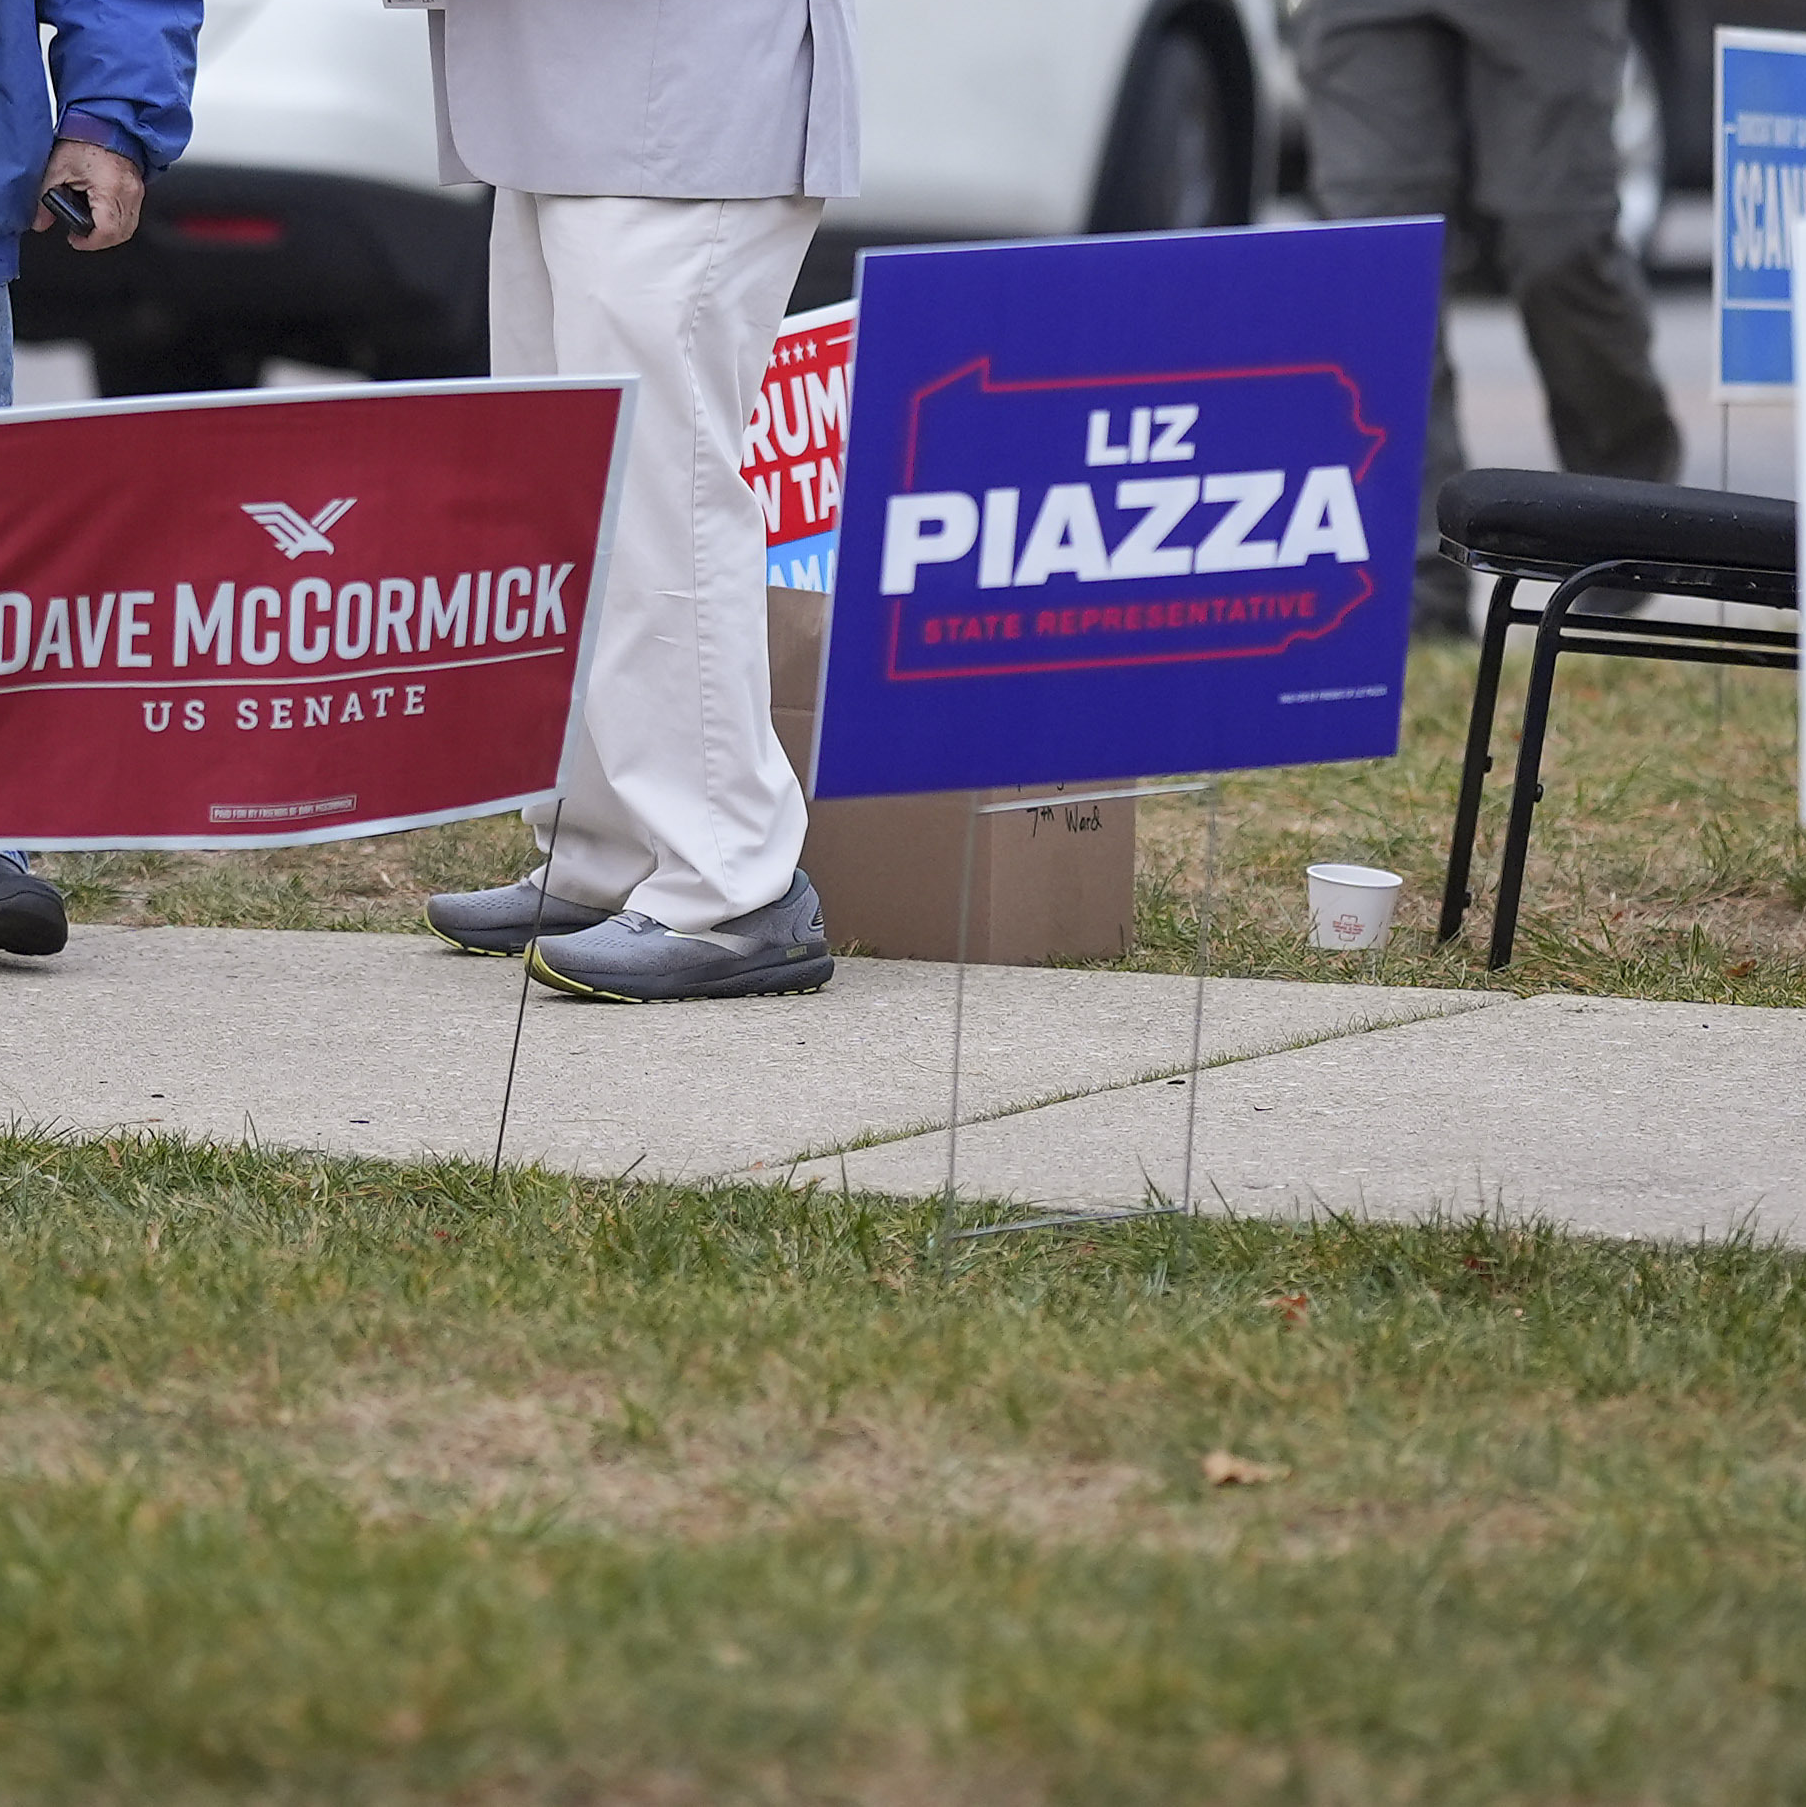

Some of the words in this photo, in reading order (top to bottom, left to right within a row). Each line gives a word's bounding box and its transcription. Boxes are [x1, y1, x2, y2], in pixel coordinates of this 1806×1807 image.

[742, 363, 853, 469] RUM
[1084, 402, 1199, 468] LIZ
[880, 465, 1370, 597] PIAZZA
[922, 611, 1023, 645] STATE
[1035, 592, 1317, 637] REPRESENTATIVE
[142, 699, 206, 733] US
[236, 684, 428, 732] SENATE
[1025, 805, 1055, 838] 7th
[1065, 805, 1103, 834] Ward
